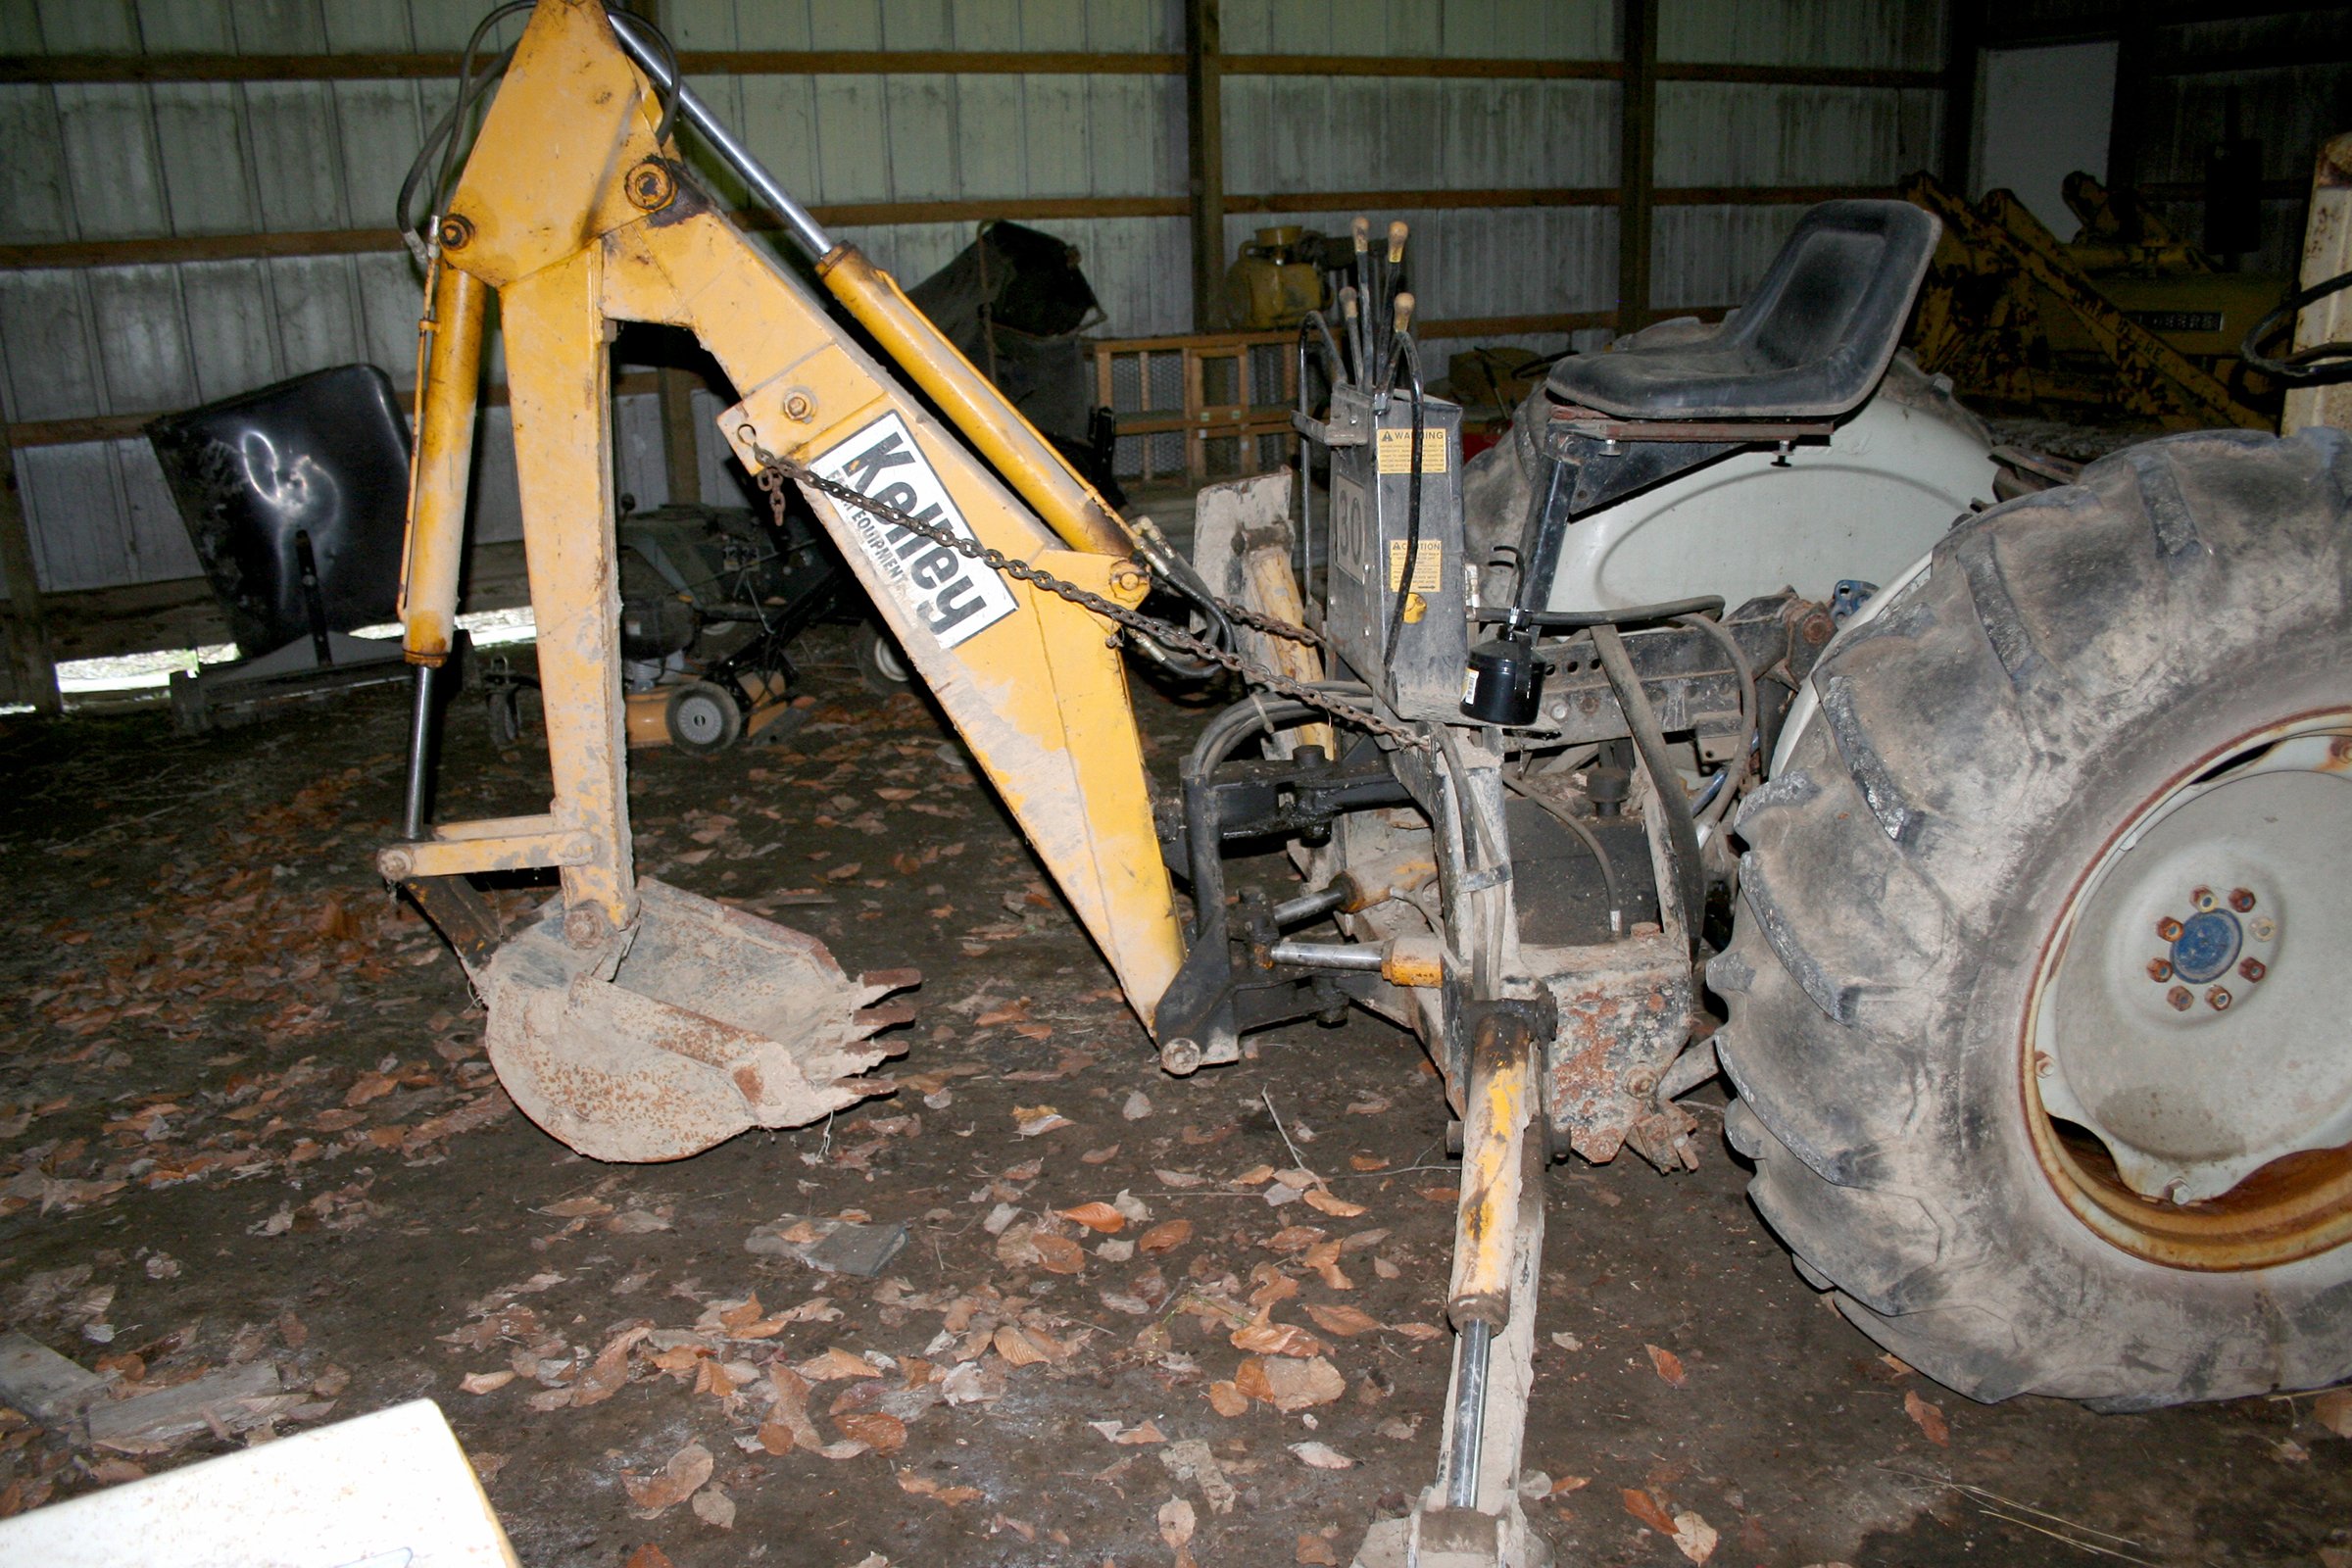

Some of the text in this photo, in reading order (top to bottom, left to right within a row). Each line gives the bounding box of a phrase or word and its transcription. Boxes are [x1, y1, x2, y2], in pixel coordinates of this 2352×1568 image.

[1395, 431, 1444, 440] WAING
[842, 431, 987, 635] Kelley
[852, 511, 908, 585] EQUIPMENT
